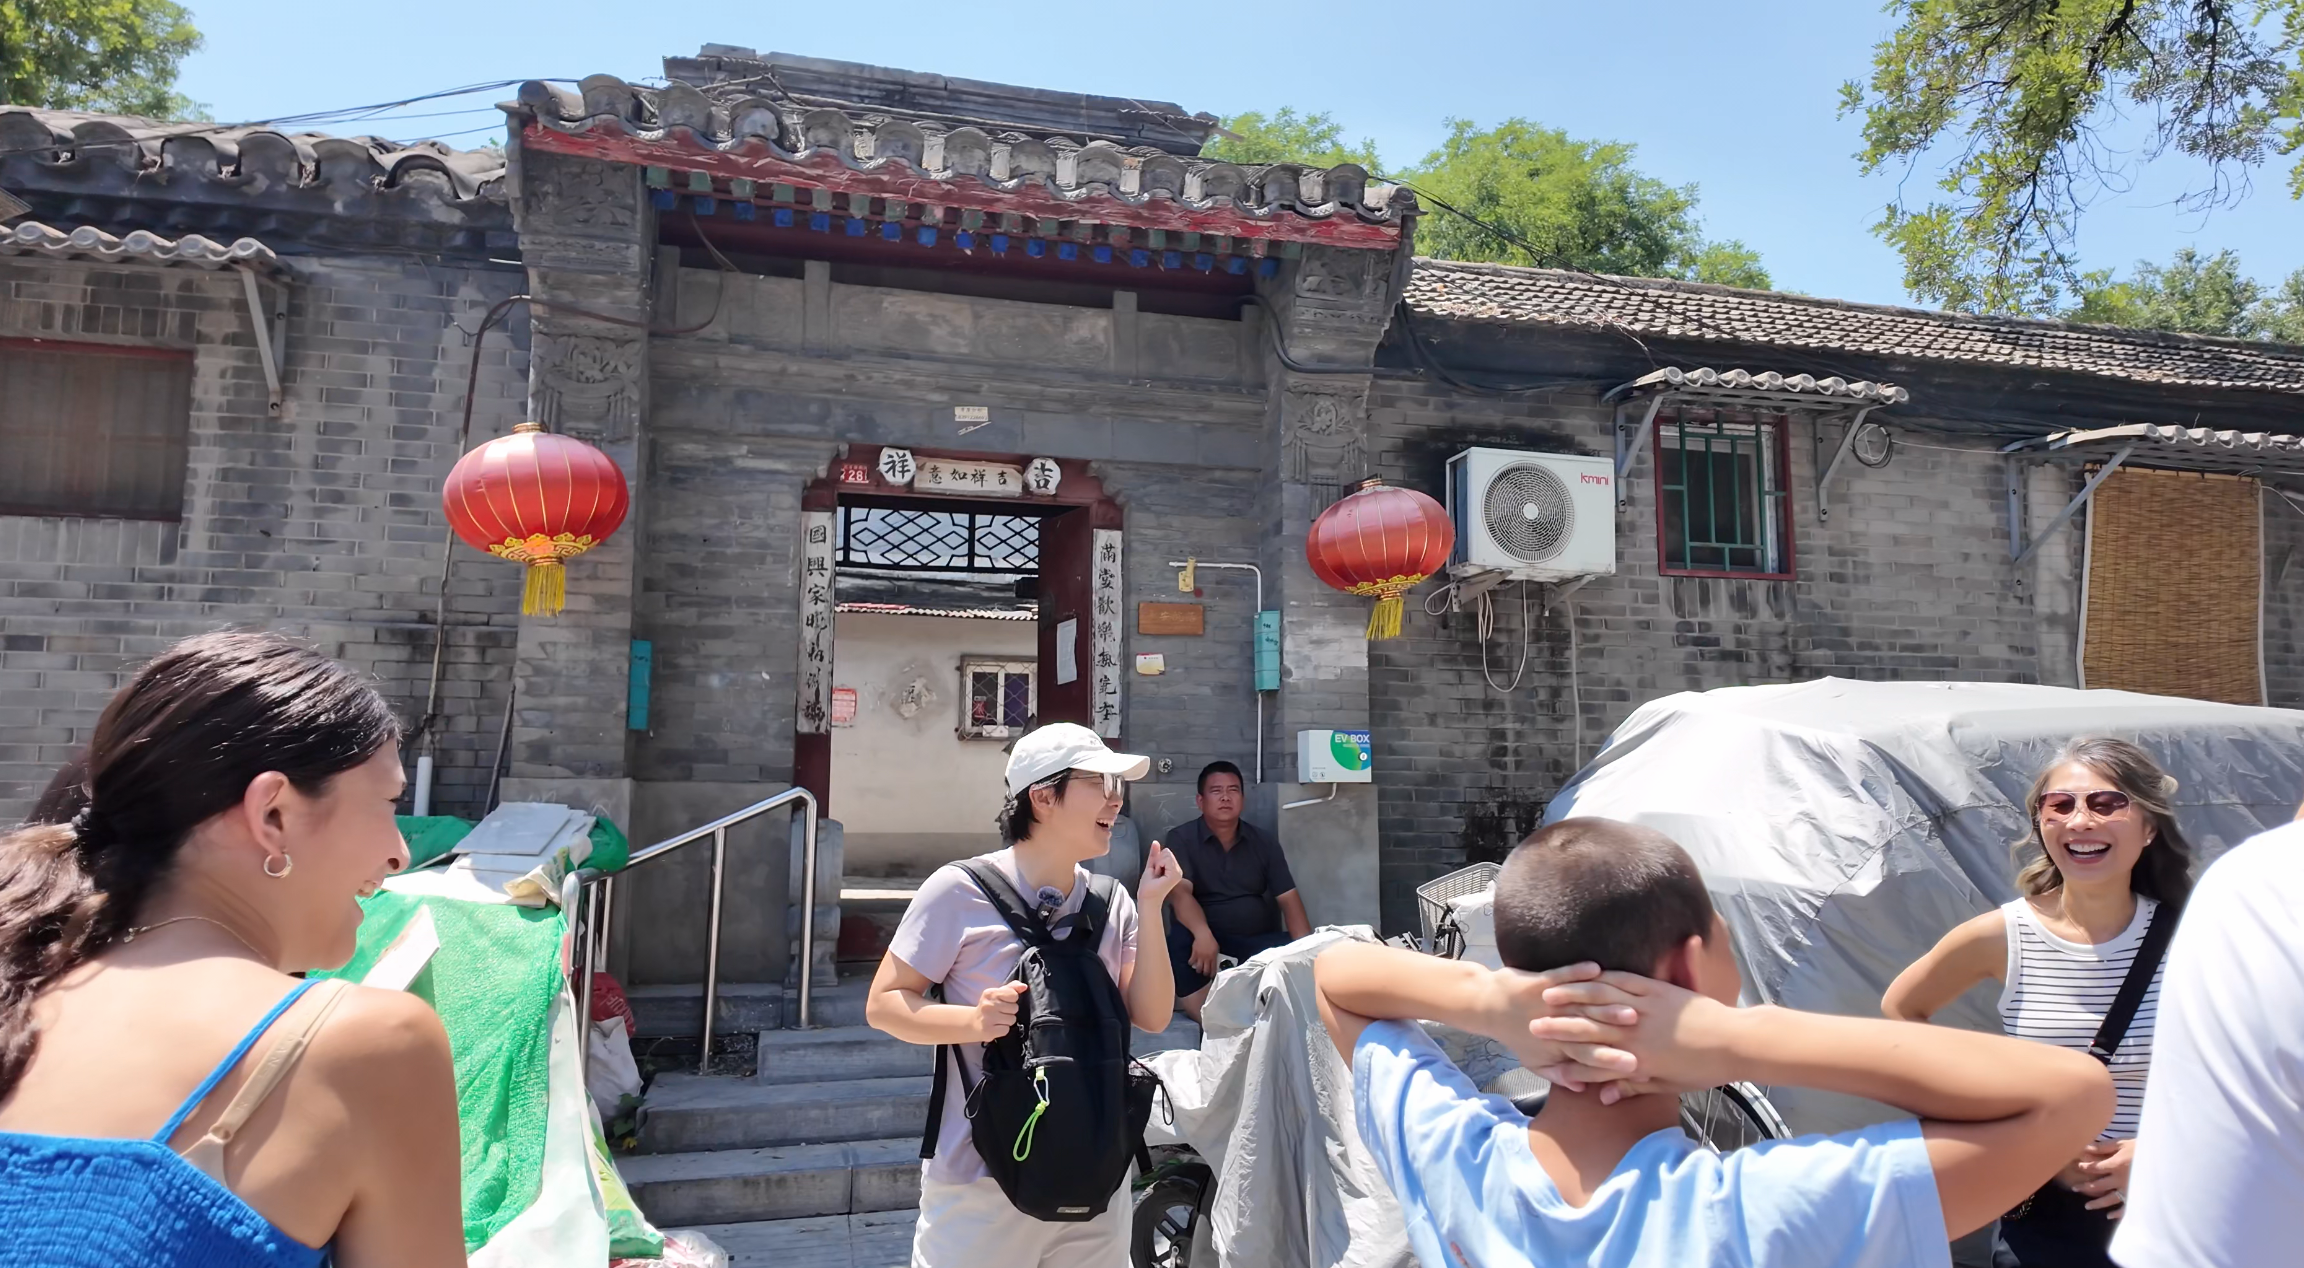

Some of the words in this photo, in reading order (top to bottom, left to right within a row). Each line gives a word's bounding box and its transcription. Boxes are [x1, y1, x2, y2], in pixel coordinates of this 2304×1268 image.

[848, 469, 863, 481] 28
[883, 452, 911, 479] 祥
[1033, 461, 1054, 490] 吉
[1335, 734, 1348, 743] EV
[1350, 734, 1370, 743] BOX
